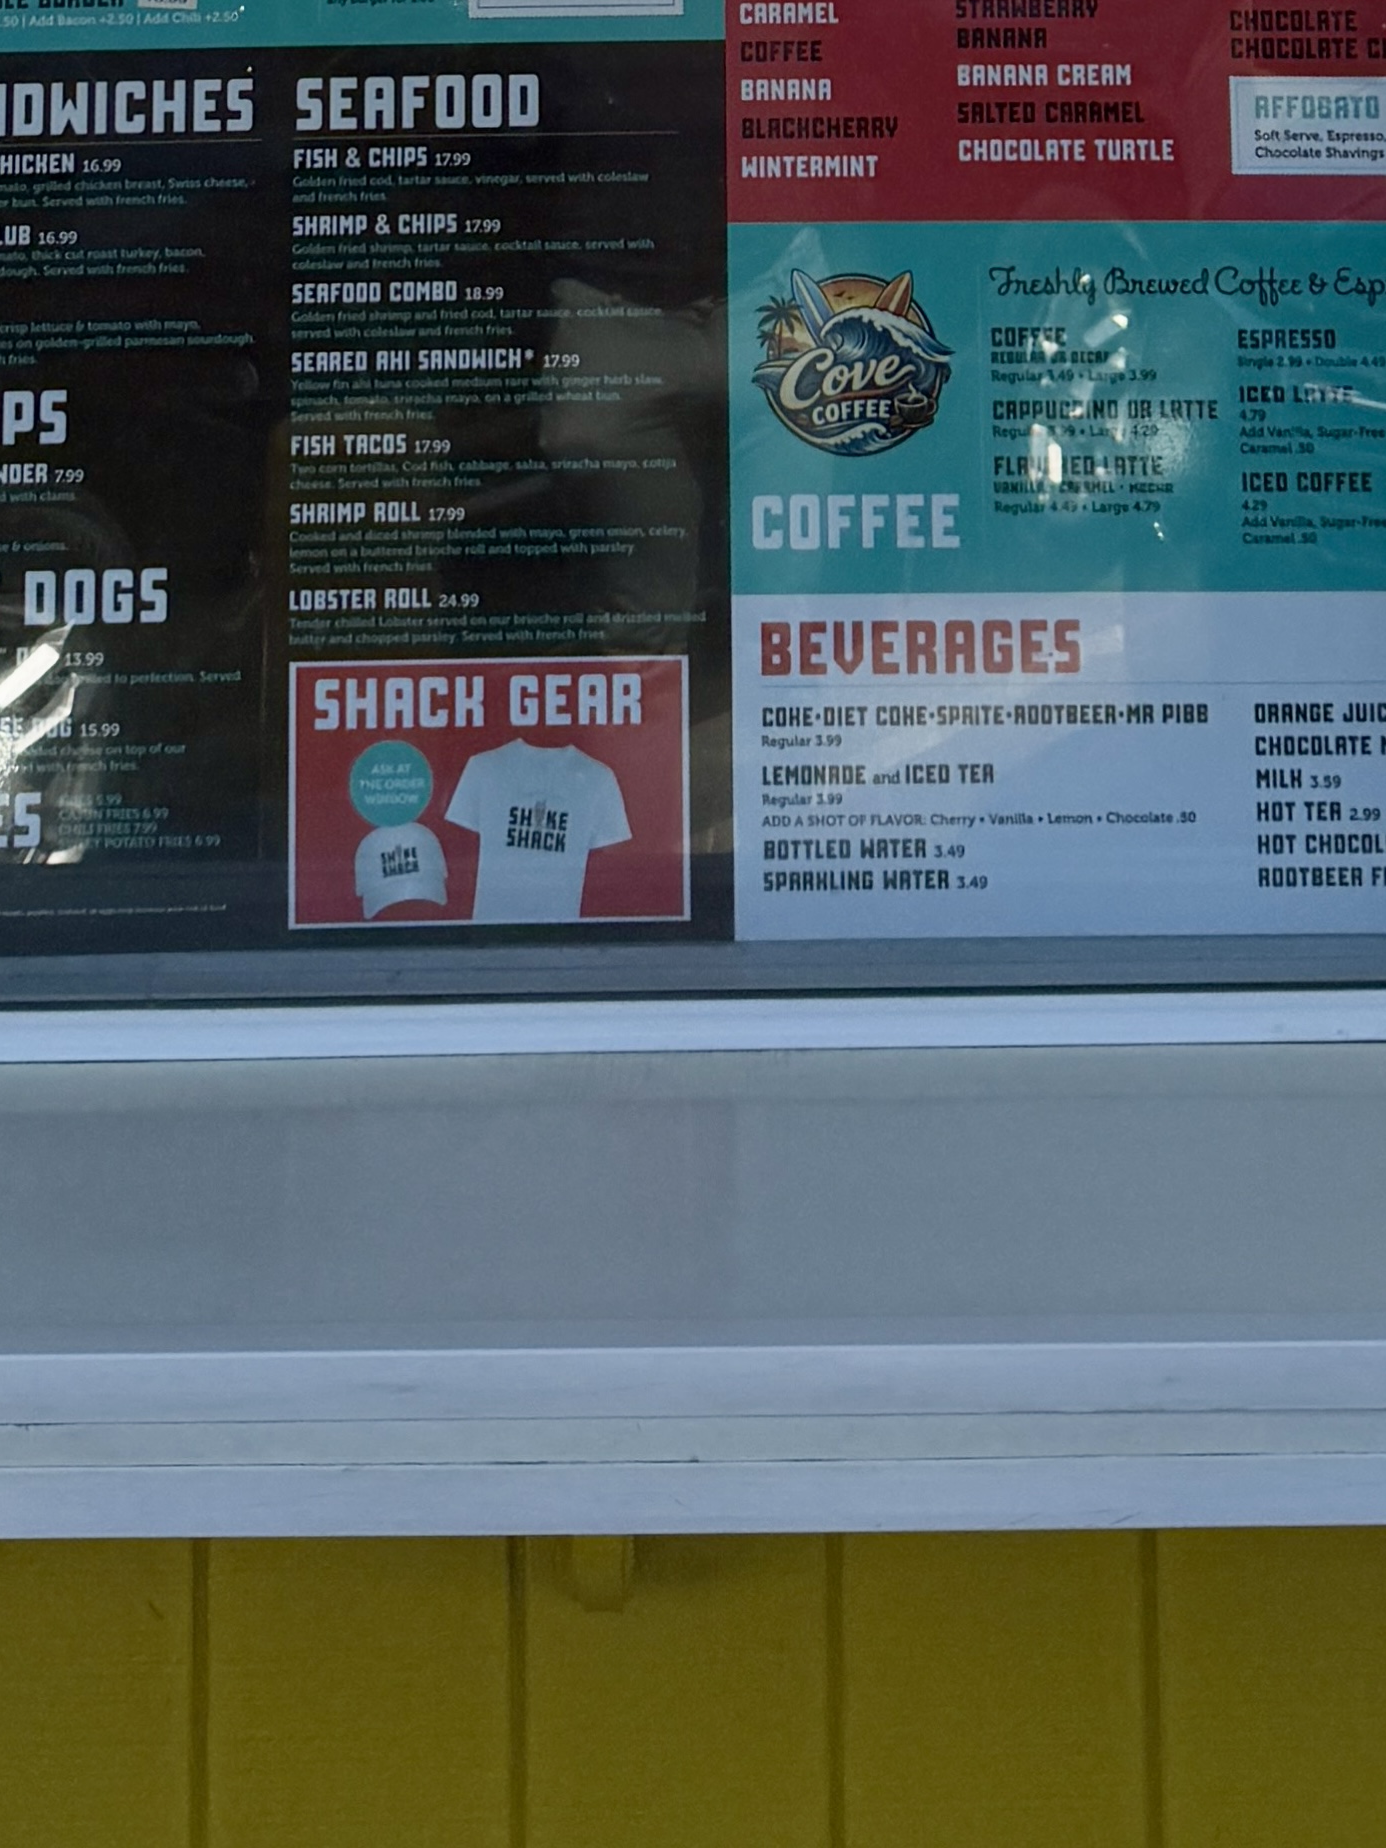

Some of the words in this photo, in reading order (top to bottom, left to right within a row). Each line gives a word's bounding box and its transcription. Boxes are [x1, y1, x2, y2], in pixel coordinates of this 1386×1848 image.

[739, 3, 839, 24] CARAMEL
[740, 41, 823, 62] COFFEE
[741, 80, 831, 101] BANANA
[296, 74, 540, 131] SEAFOOD
[1255, 96, 1380, 119] AFFOGATO
[742, 118, 899, 140] BLACKCHERRY
[1254, 129, 1283, 142] Soft
[82, 159, 121, 172] 16.99
[294, 149, 337, 169] FISH
[345, 148, 360, 167] &
[368, 147, 427, 167] CHIPS
[434, 153, 471, 166] 17.99
[742, 156, 878, 178] WINTERMINT
[38, 231, 77, 245] 16.99
[989, 266, 1096, 305] Freshly
[1104, 267, 1209, 295] Brewed
[1215, 266, 1301, 305] Coffee
[1309, 273, 1327, 294] &
[779, 348, 915, 409] Cove
[812, 400, 891, 425] COFFEE
[292, 435, 336, 456] FISH
[344, 434, 406, 453] TACOS
[414, 440, 451, 453] 17.99
[752, 494, 960, 550] COFFEE
[24, 567, 168, 625] DOGS
[290, 590, 376, 610] LOBSTER
[385, 588, 431, 609] ROLL
[439, 594, 480, 607] 24.99
[761, 619, 1081, 676] BEVERAGES
[314, 675, 484, 730] SHACK
[510, 673, 641, 726] GEAR
[1255, 702, 1334, 723] ORANGE
[763, 839, 851, 861] BOTTLED
[860, 838, 926, 859] WATER
[934, 845, 964, 857] 3.49
[1257, 834, 1295, 854] HOT
